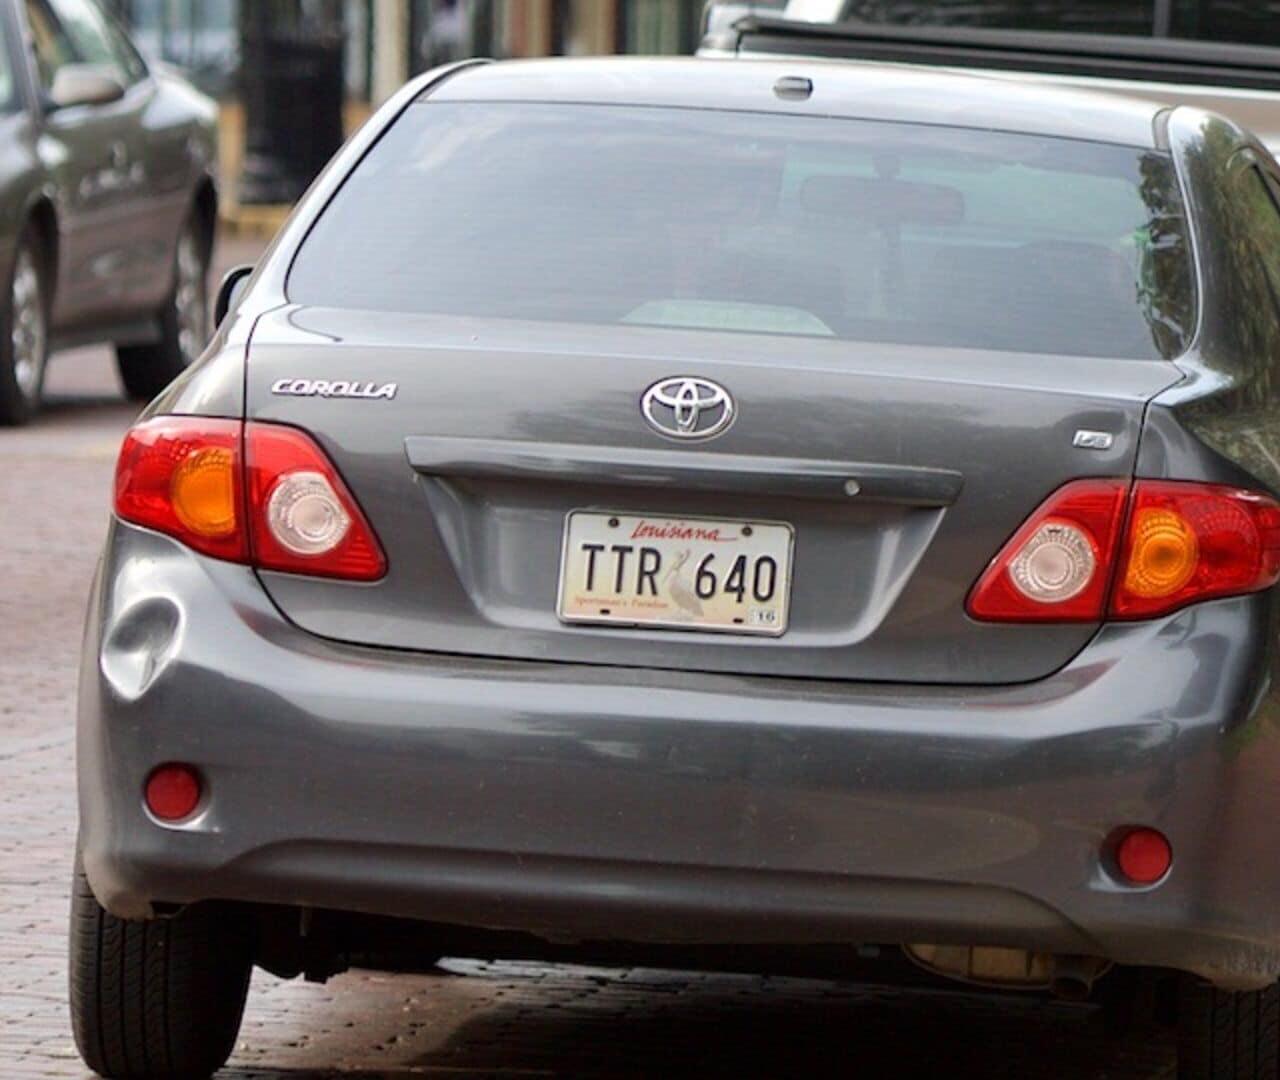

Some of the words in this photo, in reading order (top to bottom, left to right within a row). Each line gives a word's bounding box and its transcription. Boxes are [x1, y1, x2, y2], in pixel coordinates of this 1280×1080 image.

[271, 379, 398, 400] COROLLA
[630, 519, 738, 542] Louisiana
[581, 544, 662, 596] TTR
[695, 553, 777, 603] 640
